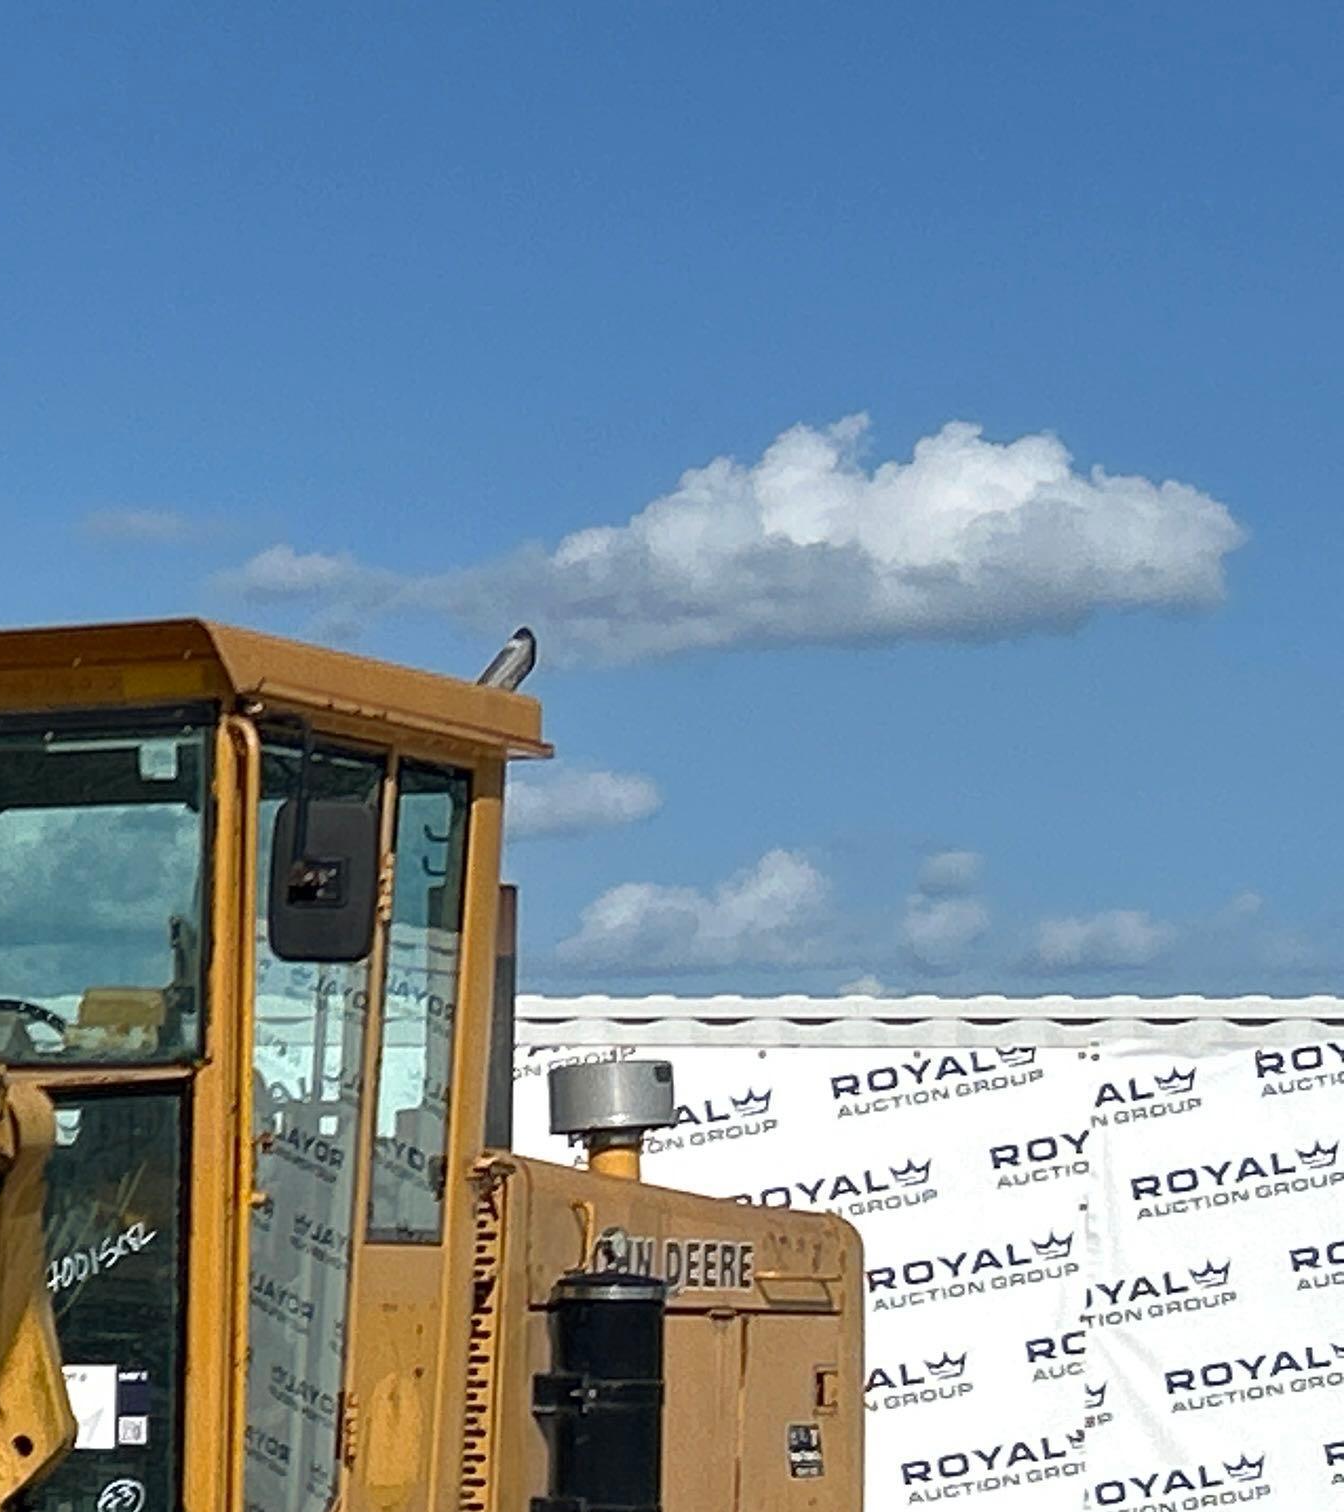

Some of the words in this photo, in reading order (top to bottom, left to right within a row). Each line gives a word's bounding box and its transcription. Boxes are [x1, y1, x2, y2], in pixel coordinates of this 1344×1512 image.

[830, 1051, 997, 1100] ROYAL
[838, 1088, 950, 1119] AUCTION
[955, 1069, 1044, 1098] GROUP
[689, 1119, 778, 1145] GROUP
[1113, 1097, 1202, 1125] GROUP
[1130, 1153, 1296, 1200] ROYAL
[1137, 1189, 1249, 1220] AUCTION
[1255, 1171, 1344, 1199] GROUP
[848, 1189, 938, 1216] GROUP
[666, 1242, 753, 1288] DEERE
[867, 1244, 1032, 1293] ROYAL
[873, 1280, 986, 1312] AUCTION
[991, 1262, 1079, 1289] GROUP
[1147, 1291, 1237, 1318] GROUP
[1165, 1347, 1331, 1394] ROYAL
[884, 1383, 974, 1410] GROUP
[1171, 1383, 1284, 1413] AUCTION
[901, 1437, 1067, 1485] ROYAL
[908, 1473, 1021, 1505] AUCTION
[1183, 1483, 1271, 1511] GROUP
